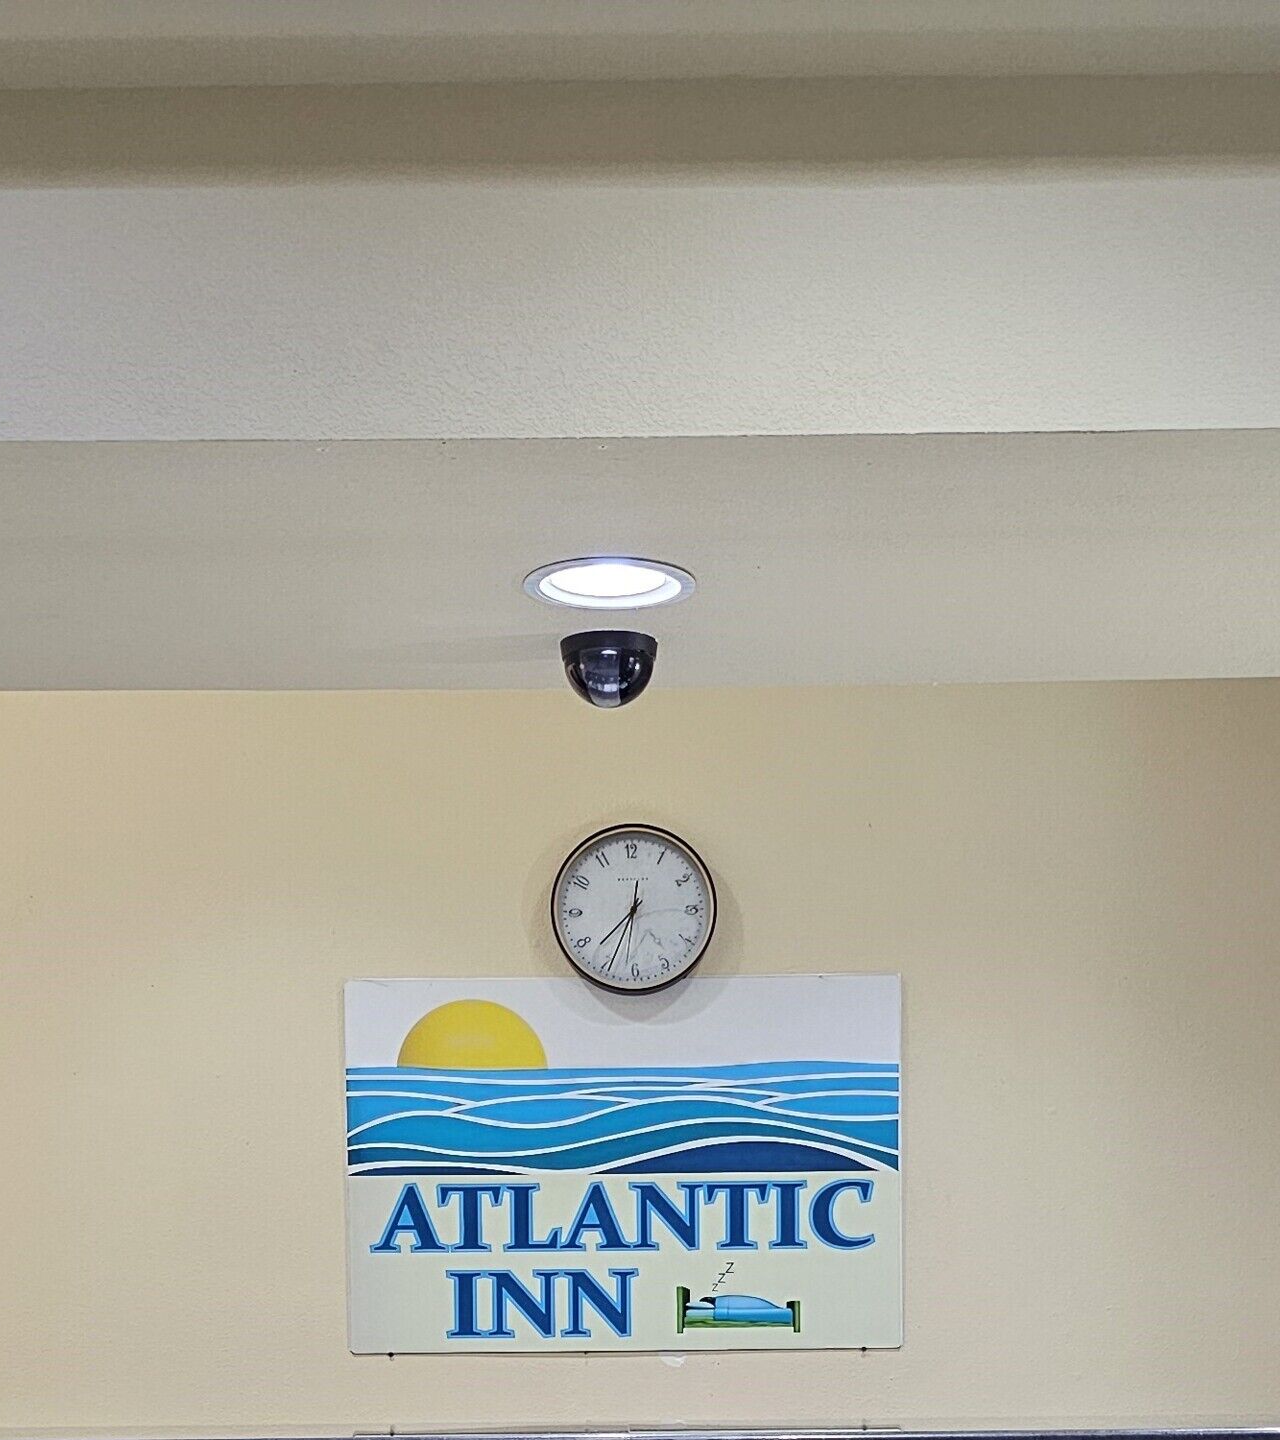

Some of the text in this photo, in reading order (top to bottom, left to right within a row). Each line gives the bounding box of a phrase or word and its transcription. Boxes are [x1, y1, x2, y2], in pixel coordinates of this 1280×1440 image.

[624, 843, 638, 859] 12
[656, 848, 667, 865] 1
[594, 851, 610, 868] 11
[573, 874, 590, 890] 10
[675, 872, 693, 887] 2
[568, 907, 583, 918] 9
[684, 904, 699, 916] 3
[576, 936, 592, 948] 8
[658, 954, 670, 970] 5
[631, 963, 640, 978] 6
[369, 1179, 876, 1254] ATLANTIC
[445, 1267, 639, 1340] INN
